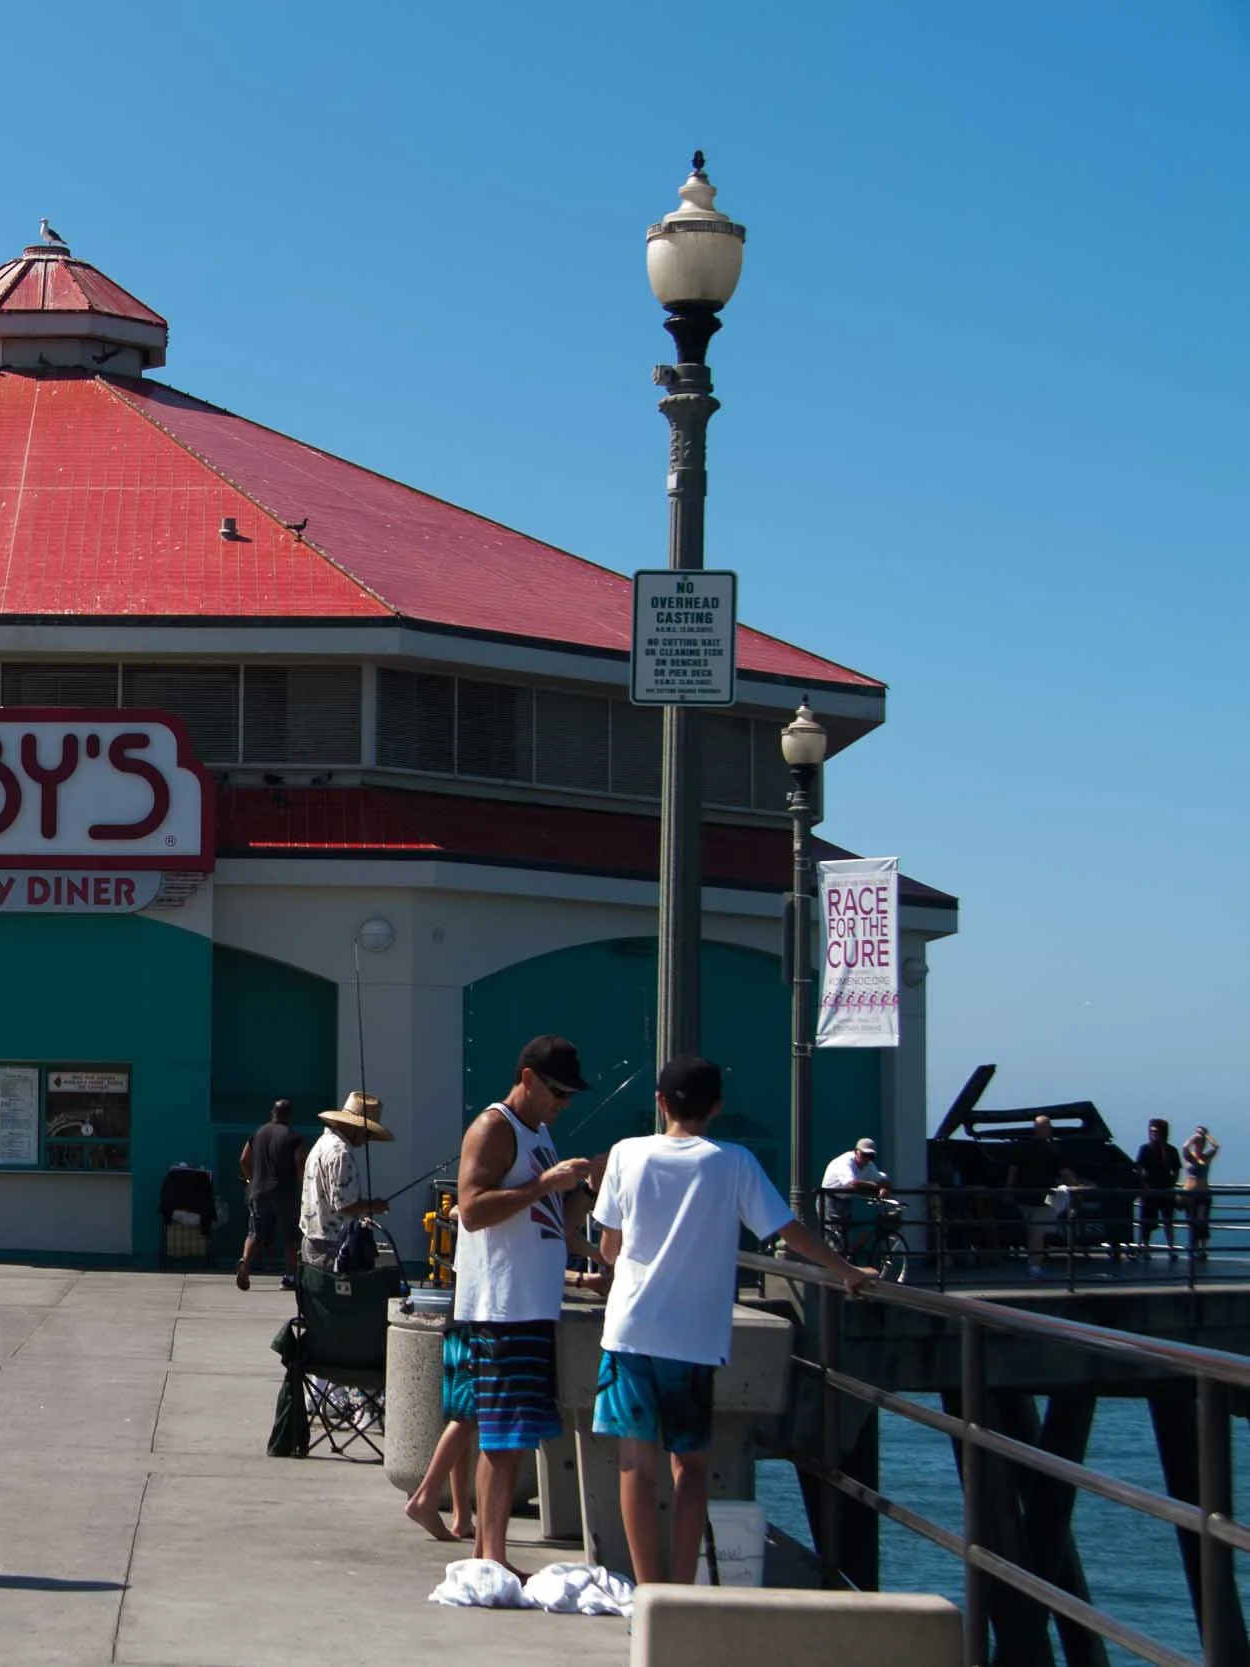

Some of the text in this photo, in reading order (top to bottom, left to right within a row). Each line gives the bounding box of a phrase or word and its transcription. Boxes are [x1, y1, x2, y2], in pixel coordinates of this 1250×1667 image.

[676, 582, 694, 594] NO
[651, 597, 720, 609] OVERHEAD
[656, 611, 714, 624] CASTING
[647, 638, 722, 646] NO CUTTING BAIT
[645, 648, 724, 656] OR CLEANING FISH
[655, 658, 709, 667] ON BENCHES
[654, 668, 713, 677] OR PIER DECK
[27, 876, 136, 906] DINER
[827, 886, 889, 916] RACE
[828, 916, 888, 938] FOR THE
[827, 939, 890, 968] CURE
